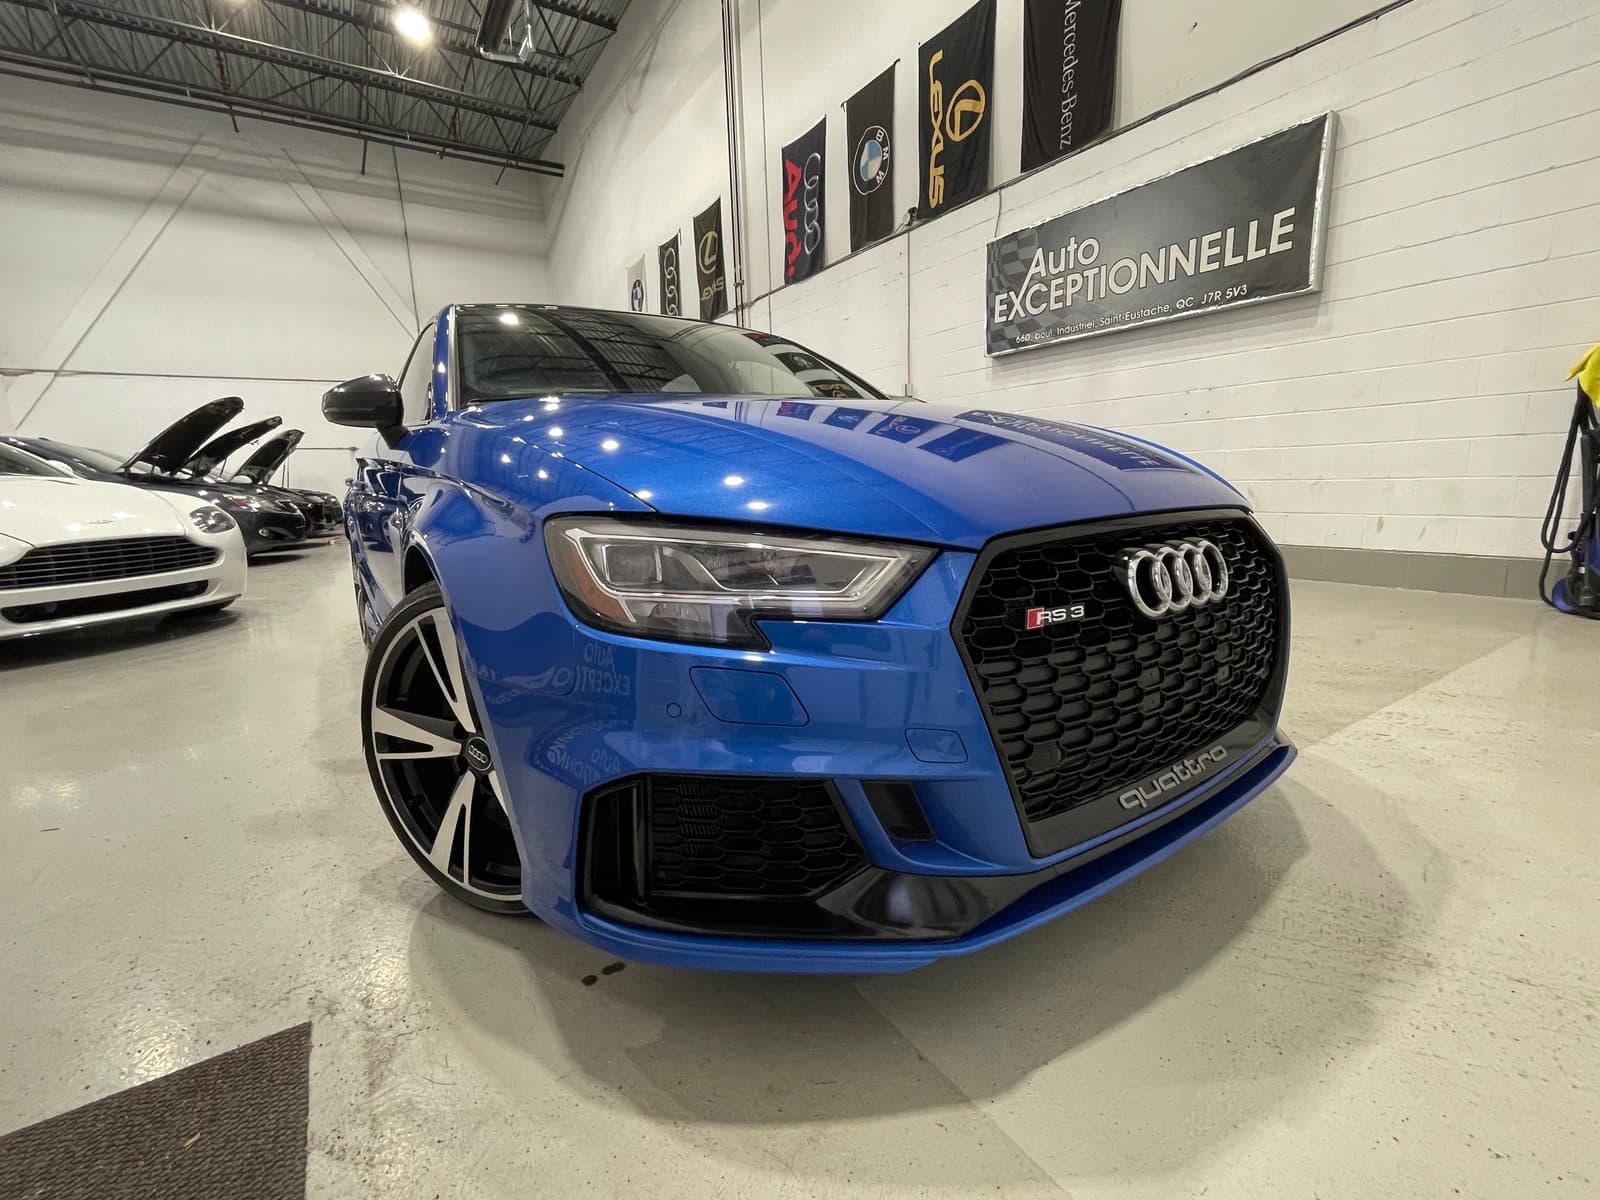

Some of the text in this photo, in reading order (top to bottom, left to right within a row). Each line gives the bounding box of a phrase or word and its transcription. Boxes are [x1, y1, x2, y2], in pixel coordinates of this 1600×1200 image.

[875, 129, 889, 185] BMW
[928, 48, 945, 209] LEXUS
[994, 206, 1296, 324] EXCEPTIONNELLE
[1027, 237, 1100, 280] Auto
[1176, 296, 1194, 310] QC
[1201, 291, 1222, 305] J7R
[1225, 284, 1248, 299] 5V3
[1118, 744, 1228, 809] quattro
